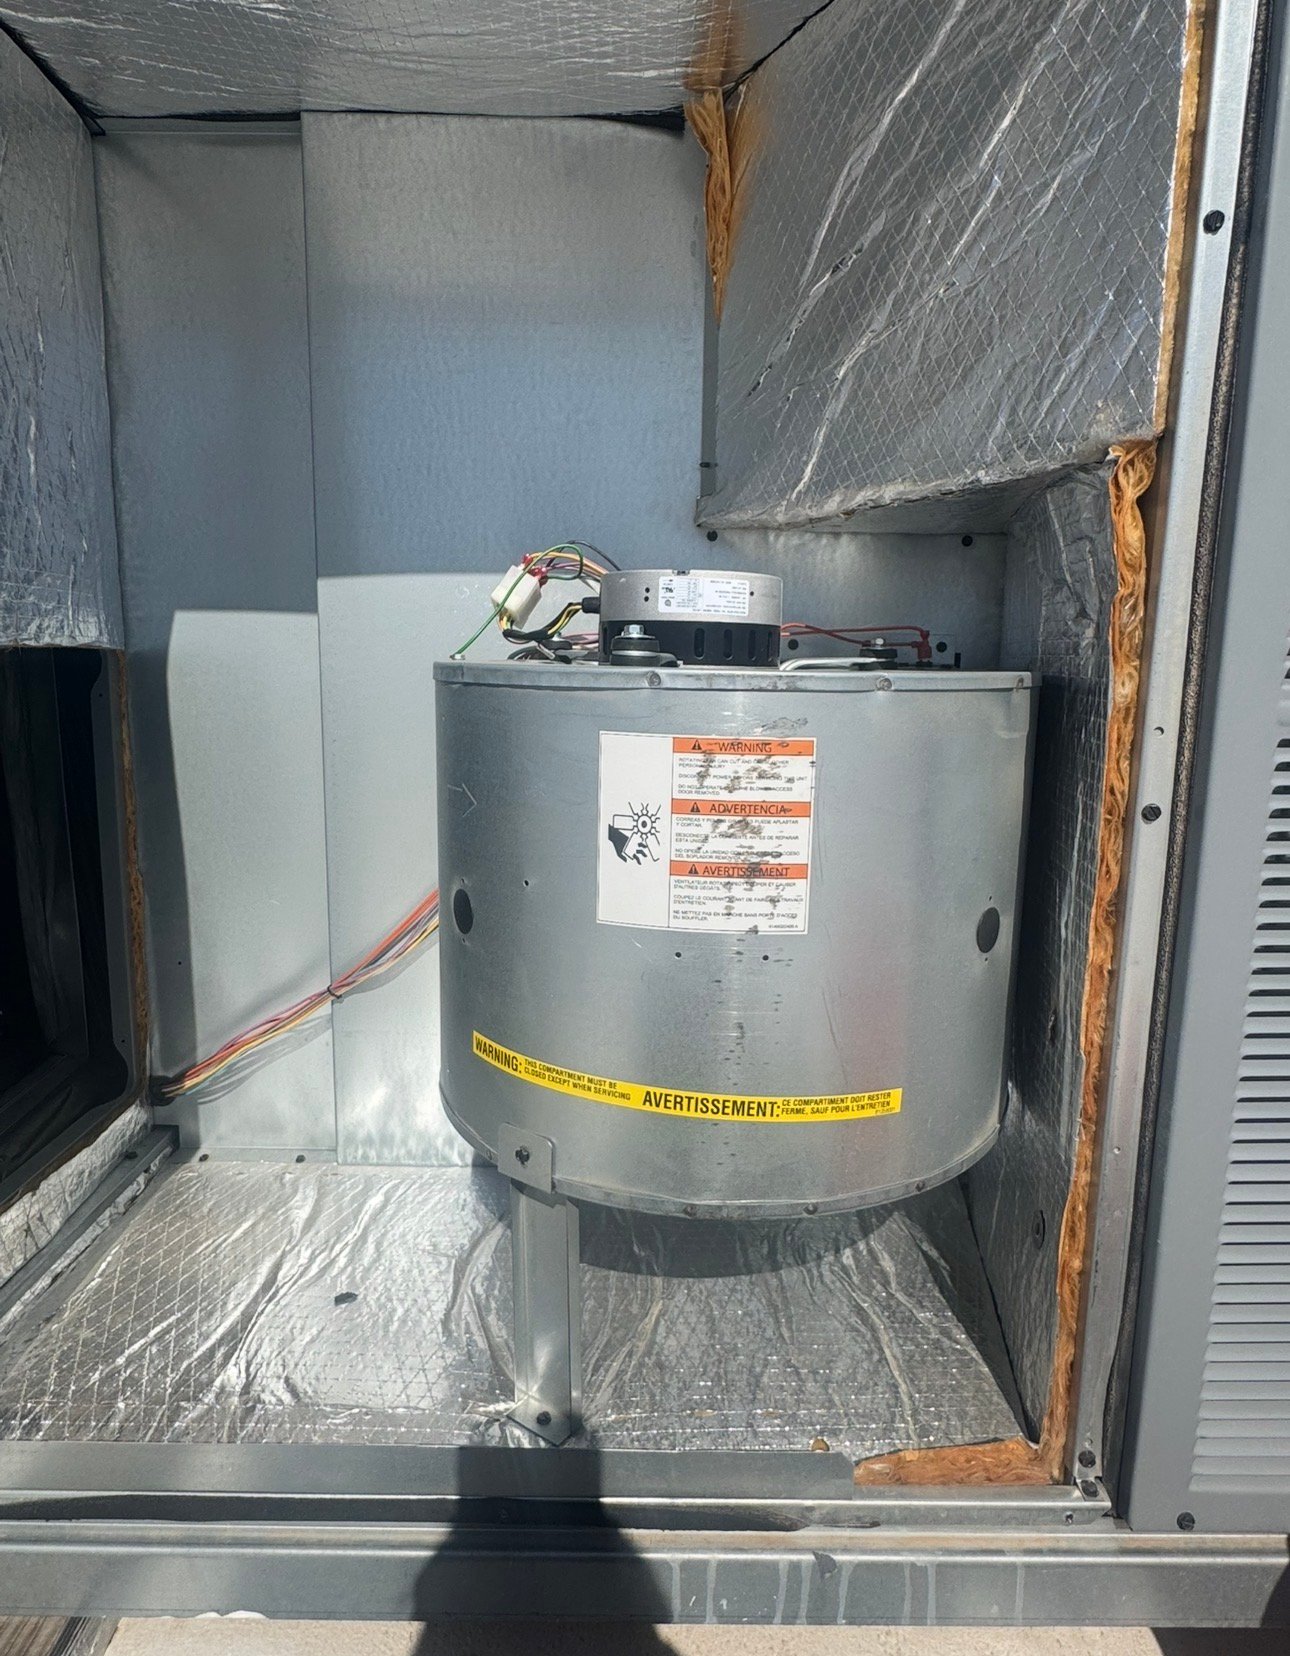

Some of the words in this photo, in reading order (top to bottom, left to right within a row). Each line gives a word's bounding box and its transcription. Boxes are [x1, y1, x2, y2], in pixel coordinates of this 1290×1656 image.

[719, 742, 772, 752] WARNING
[710, 804, 785, 814] ADVERTENCIA
[702, 866, 790, 877] AVERTISSEMENT
[475, 1035, 523, 1075] WARNING:
[524, 1058, 537, 1070] THIS
[538, 1062, 585, 1083] COMPARTMENT
[587, 1076, 607, 1087] MUST
[608, 1081, 617, 1089] BE
[524, 1066, 547, 1080] CLOSED
[548, 1074, 571, 1087] EXCEPT
[572, 1081, 593, 1092] WHEN
[593, 1086, 631, 1101] SERVICING
[642, 1090, 781, 1118] AVERTISSEMENT:
[793, 1096, 849, 1107] COMPARTIMENT
[850, 1094, 866, 1103] DOIT
[867, 1092, 892, 1102] RESTER
[810, 1105, 830, 1114] SAUF
[831, 1104, 850, 1113] POUR
[851, 1100, 891, 1112] L'ENTRETIEN
